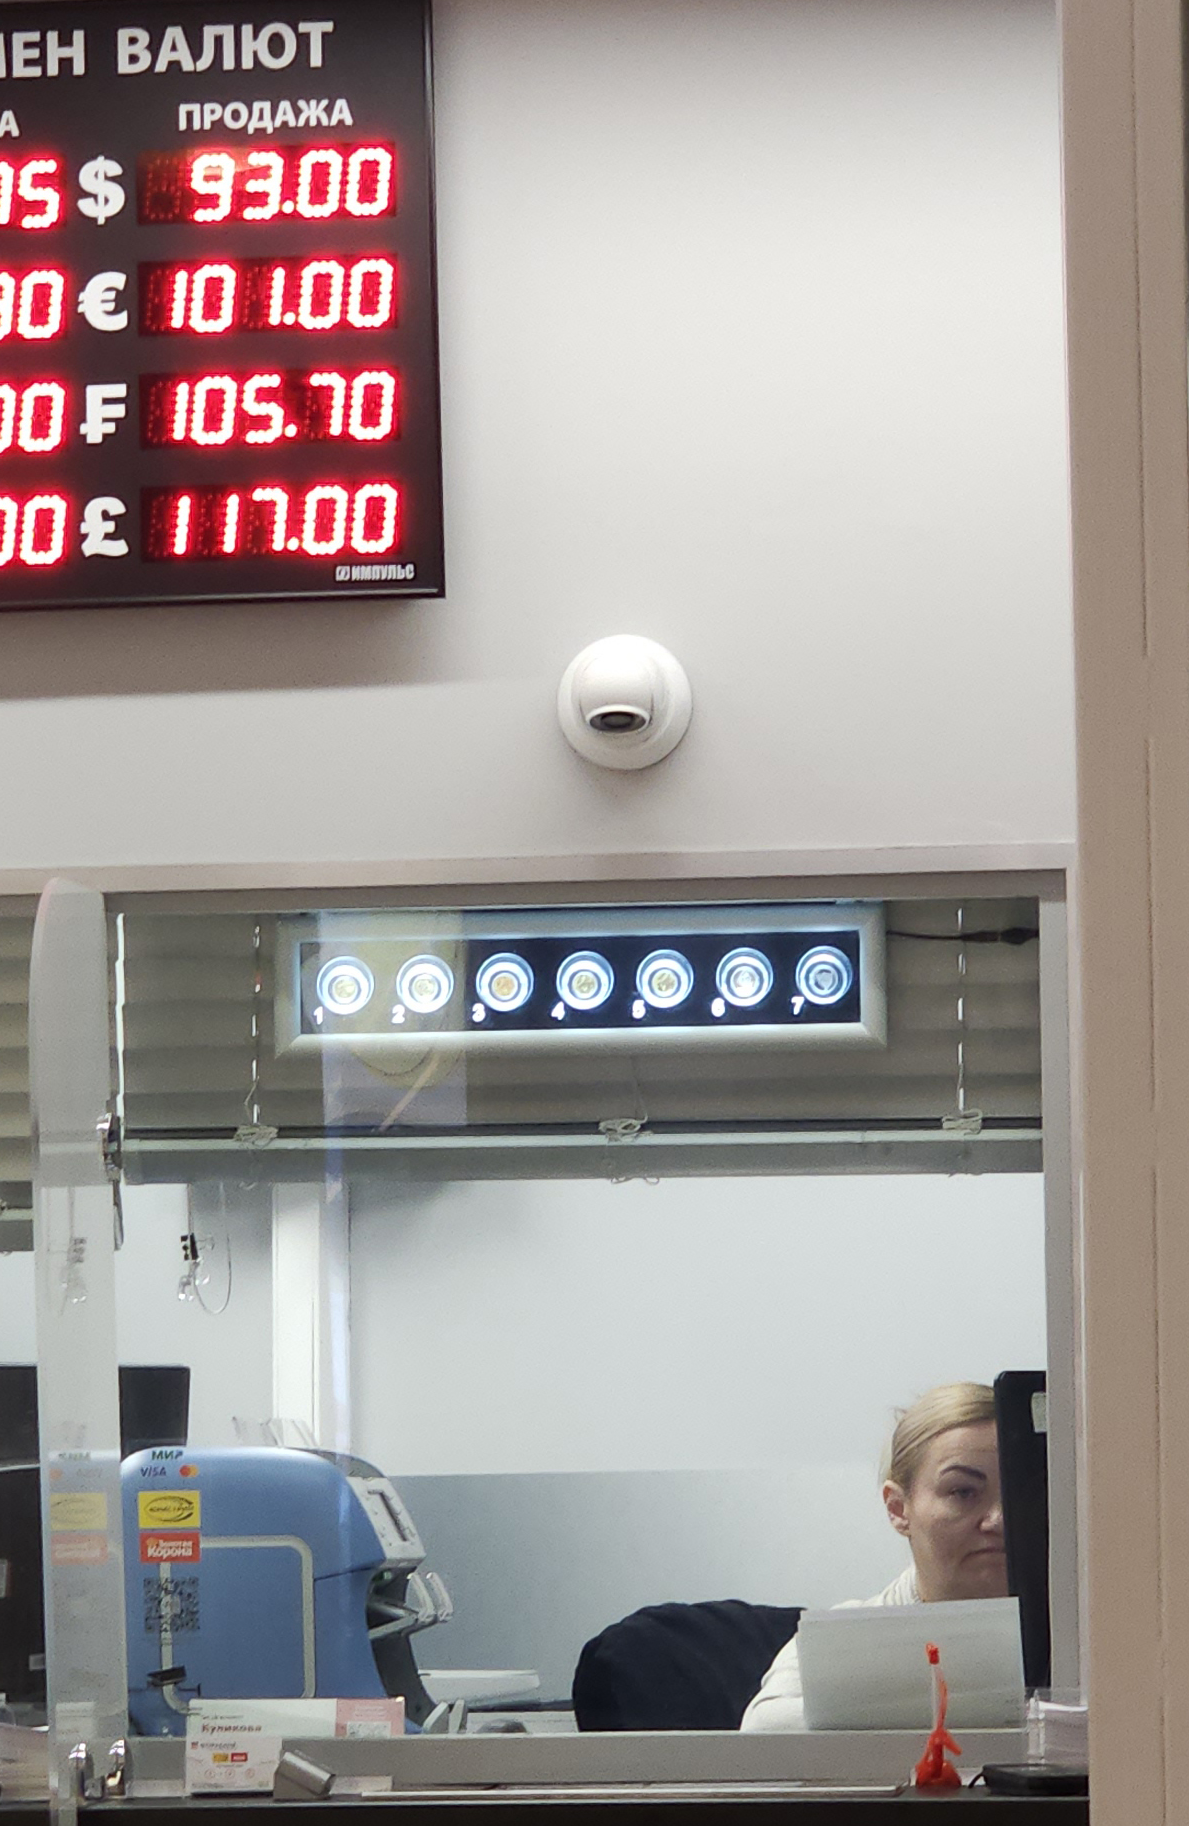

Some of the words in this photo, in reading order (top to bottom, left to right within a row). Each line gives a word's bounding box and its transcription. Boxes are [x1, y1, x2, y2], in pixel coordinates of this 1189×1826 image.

[117, 21, 334, 74] ВАЛЮТ
[178, 98, 354, 135] ПРОДАЖА
[77, 154, 126, 225] $
[187, 145, 392, 222] 93.00
[77, 271, 128, 332] €
[167, 257, 394, 333] 101.00
[168, 369, 395, 446] 105.70
[80, 496, 129, 558] £
[171, 483, 398, 556] 117.00
[351, 564, 415, 582] ИМПУЛЬС
[314, 1006, 324, 1025] 1
[391, 1005, 406, 1024] 2
[472, 1003, 486, 1022] 3
[551, 1001, 566, 1020] 4
[632, 1000, 646, 1019] 5
[711, 998, 726, 1017] 6
[791, 996, 804, 1014] 7
[140, 1466, 167, 1478] VISA
[151, 1450, 183, 1461] МИР
[147, 1545, 193, 1559] Корона
